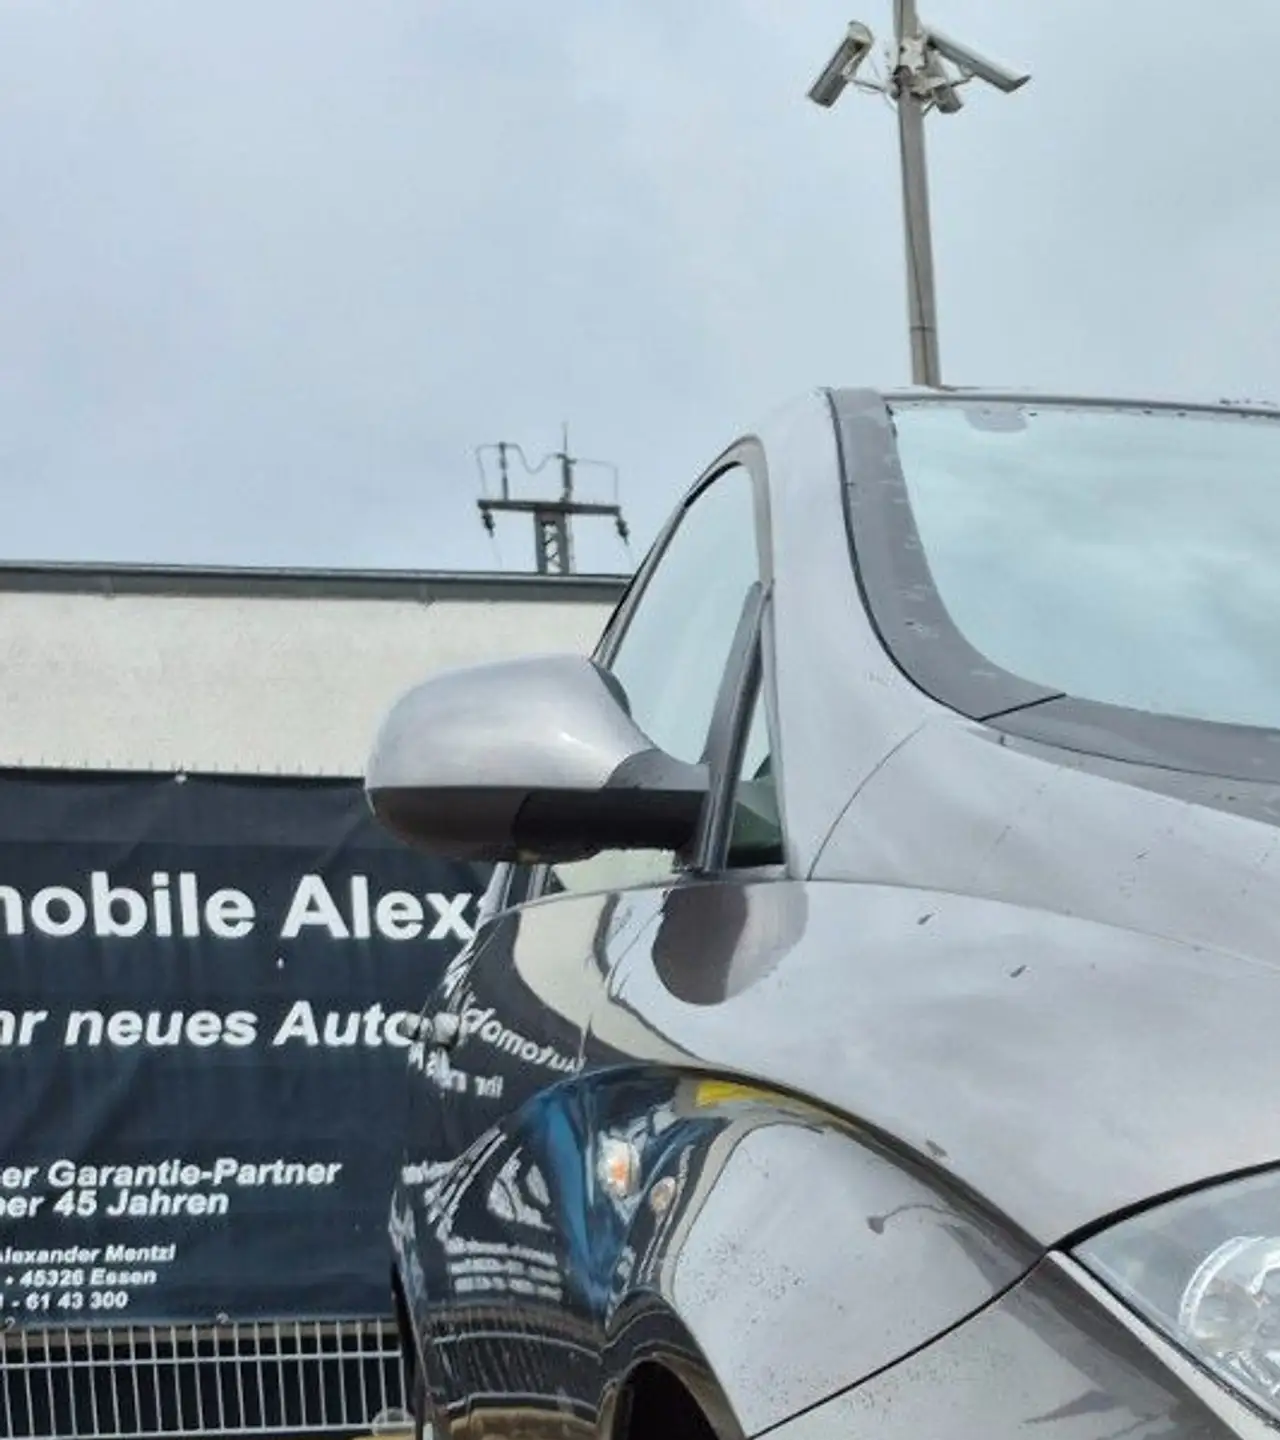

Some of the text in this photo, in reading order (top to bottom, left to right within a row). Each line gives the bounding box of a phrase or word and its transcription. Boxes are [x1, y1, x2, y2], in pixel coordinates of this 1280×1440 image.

[64, 1009, 259, 1047] neues
[0, 1158, 343, 1189] er Garantie-Partner
[52, 1189, 98, 1217] 45
[106, 1189, 229, 1217] Jahren
[0, 1246, 101, 1265] lexander
[90, 1267, 157, 1286] Essen
[25, 1291, 51, 1311] 61
[57, 1290, 84, 1310] 43
[89, 1290, 130, 1310] 300
